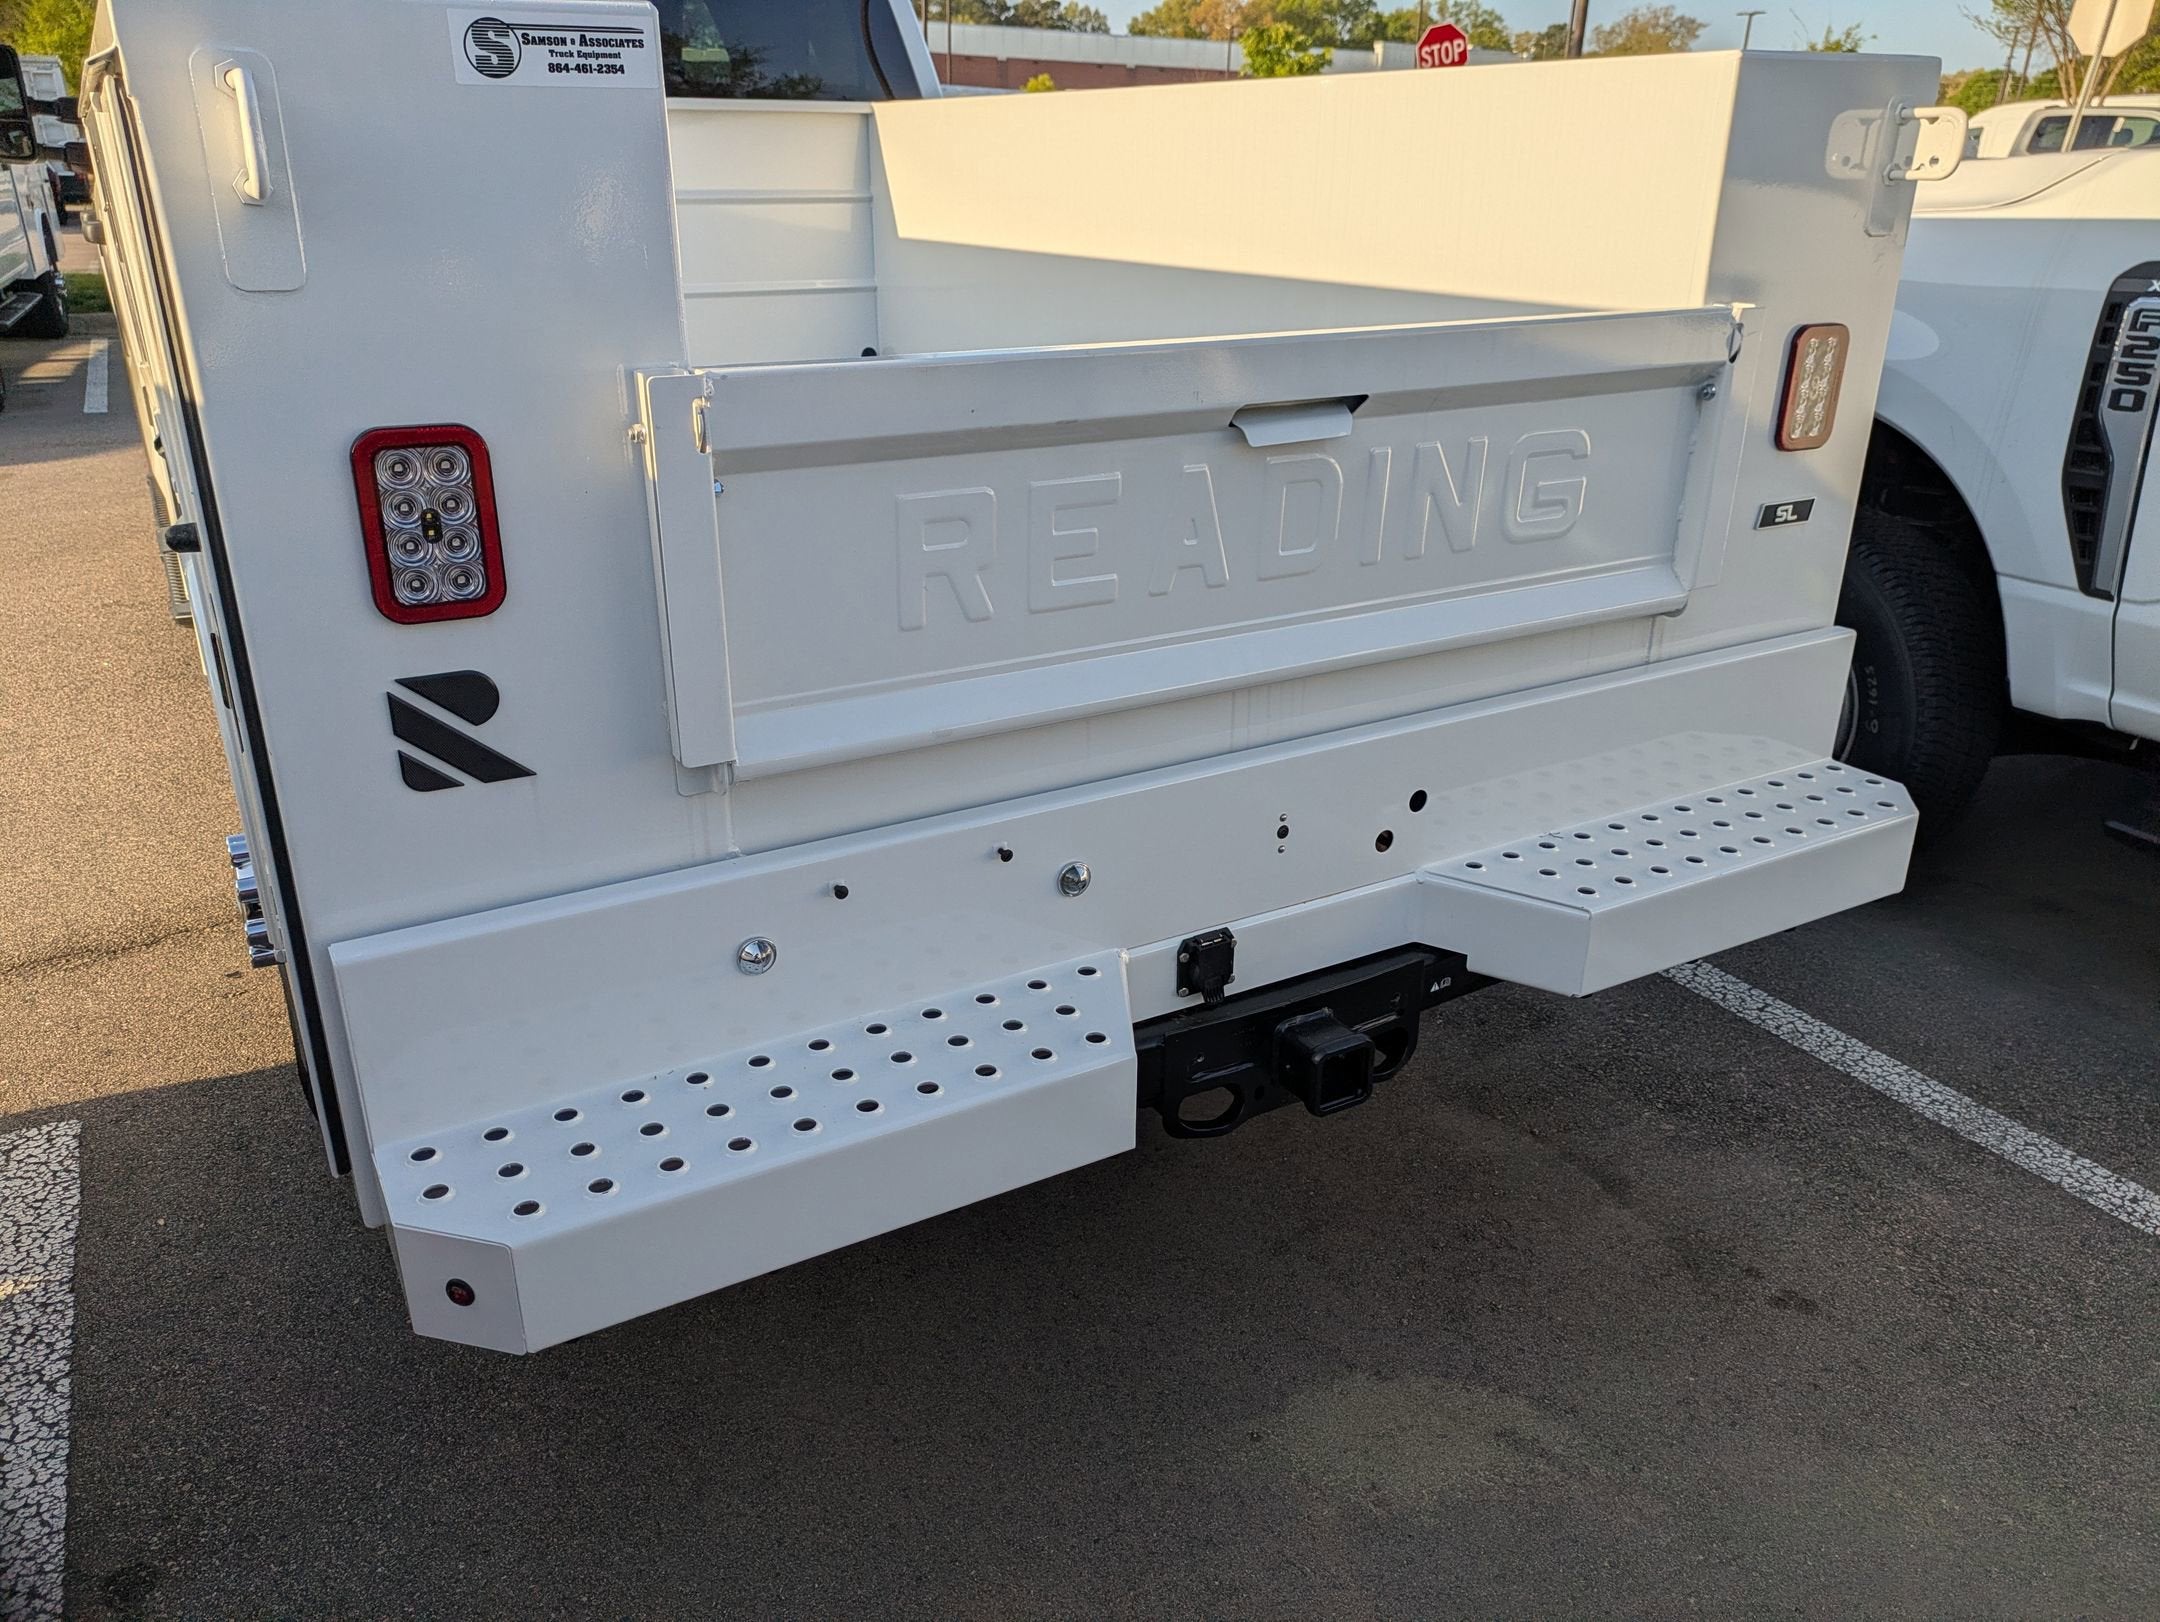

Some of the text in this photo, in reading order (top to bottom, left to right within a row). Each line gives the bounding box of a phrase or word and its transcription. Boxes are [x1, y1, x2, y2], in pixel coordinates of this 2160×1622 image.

[521, 33, 567, 46] SAMSON
[579, 34, 645, 49] ASSOCIATES
[548, 49, 622, 60] Truck Equipment
[1421, 38, 1465, 68] STOP
[548, 62, 625, 74] 864-461-2354
[1774, 504, 1798, 522] SL
[896, 428, 1592, 632] READING
